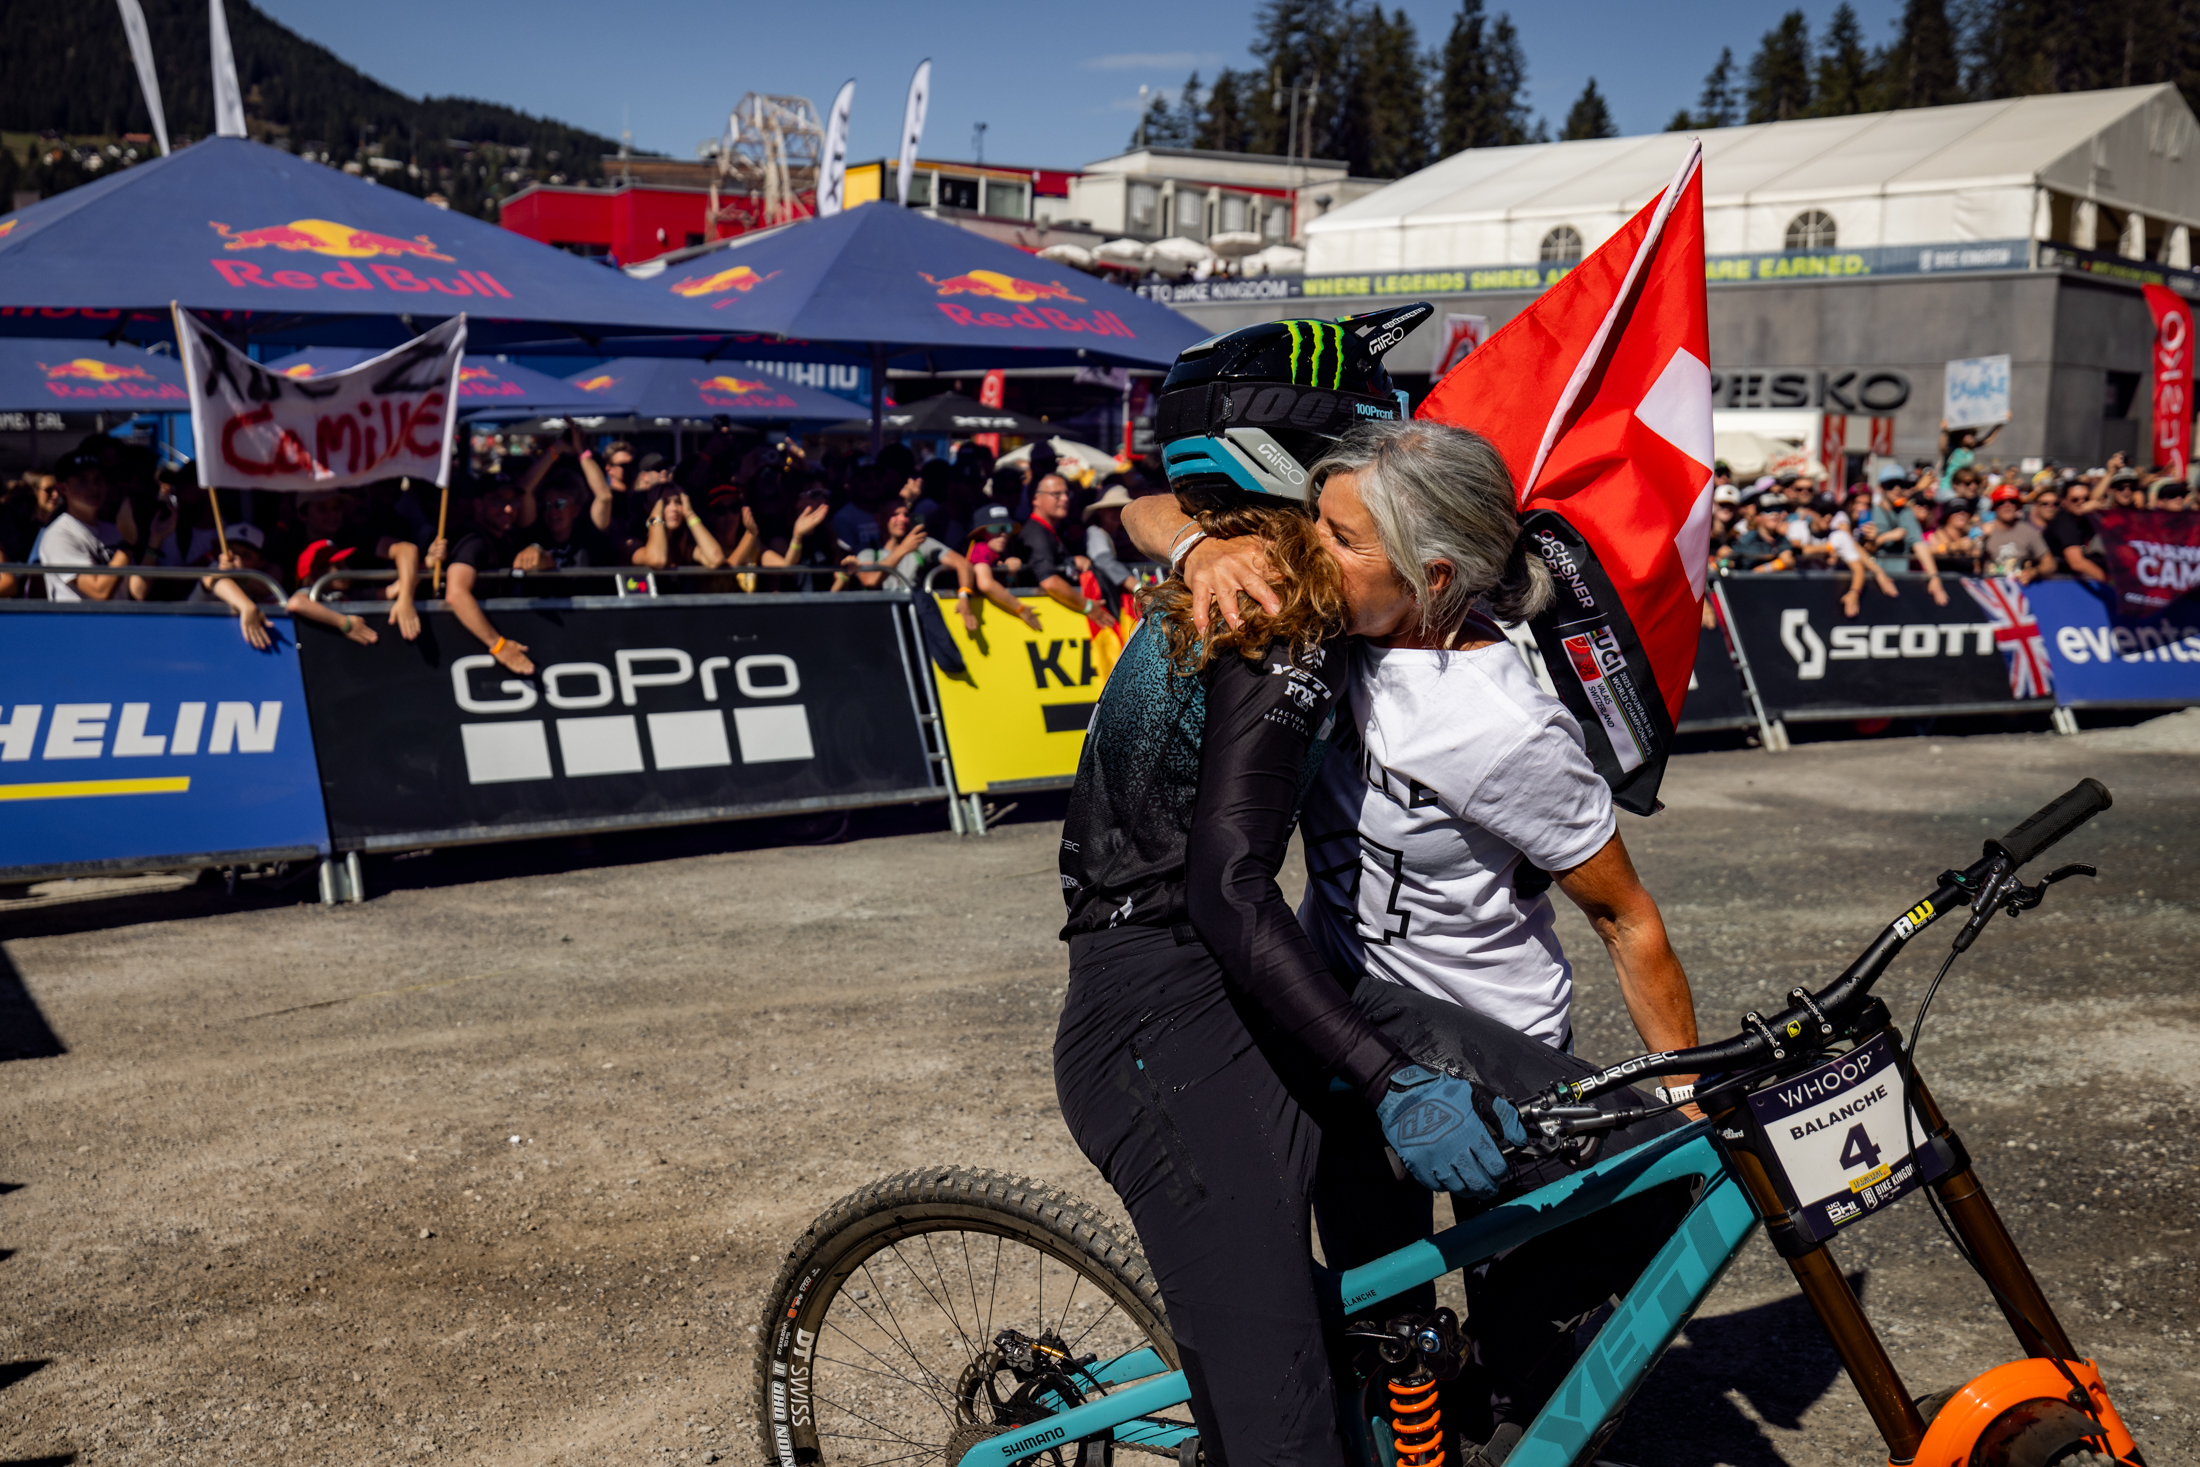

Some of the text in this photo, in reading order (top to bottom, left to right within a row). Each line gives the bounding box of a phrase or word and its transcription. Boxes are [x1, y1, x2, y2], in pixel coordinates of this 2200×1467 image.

[210, 258, 515, 299] Red Bull
[1211, 279, 1288, 298] KINGDOM
[1302, 276, 1371, 296] WHERE
[1374, 271, 1466, 294] LEGENDS
[935, 302, 1138, 340] Red Bull
[1369, 326, 1404, 356] GIRO
[1257, 442, 1305, 486] GIRO
[1540, 529, 1595, 609] OCHSNER
[1594, 633, 1622, 673] UCI
[1829, 623, 2000, 660] SCOTT
[451, 648, 800, 714] GoPro
[1284, 681, 1317, 710] FOX
[1597, 682, 1613, 705] VALAIS
[1263, 713, 1288, 725] RACE
[1588, 685, 1615, 728] SWITZERLAND
[1611, 675, 1653, 756] WORLD CHAMPIONSHIPS
[1619, 671, 1655, 739] 2025 MOUNTAIN BIKE
[0, 701, 282, 760] HELIN
[1892, 899, 1935, 938] RW
[1578, 1050, 1678, 1092] BURGTEC
[1778, 1053, 1871, 1108] WHOOP
[1789, 1084, 1888, 1140] BALANCHE
[1839, 1122, 1882, 1171] 4
[1875, 1178, 1893, 1196] BIKE
[1891, 1163, 1916, 1186] KINGDO
[1827, 1201, 1841, 1210] UCI
[1343, 1289, 1377, 1308] ALANCHE
[1531, 1199, 1731, 1463] YETI
[790, 1327, 816, 1427] DT SWISS
[771, 1380, 788, 1421] DHR
[1001, 1427, 1065, 1457] SHIMANO
